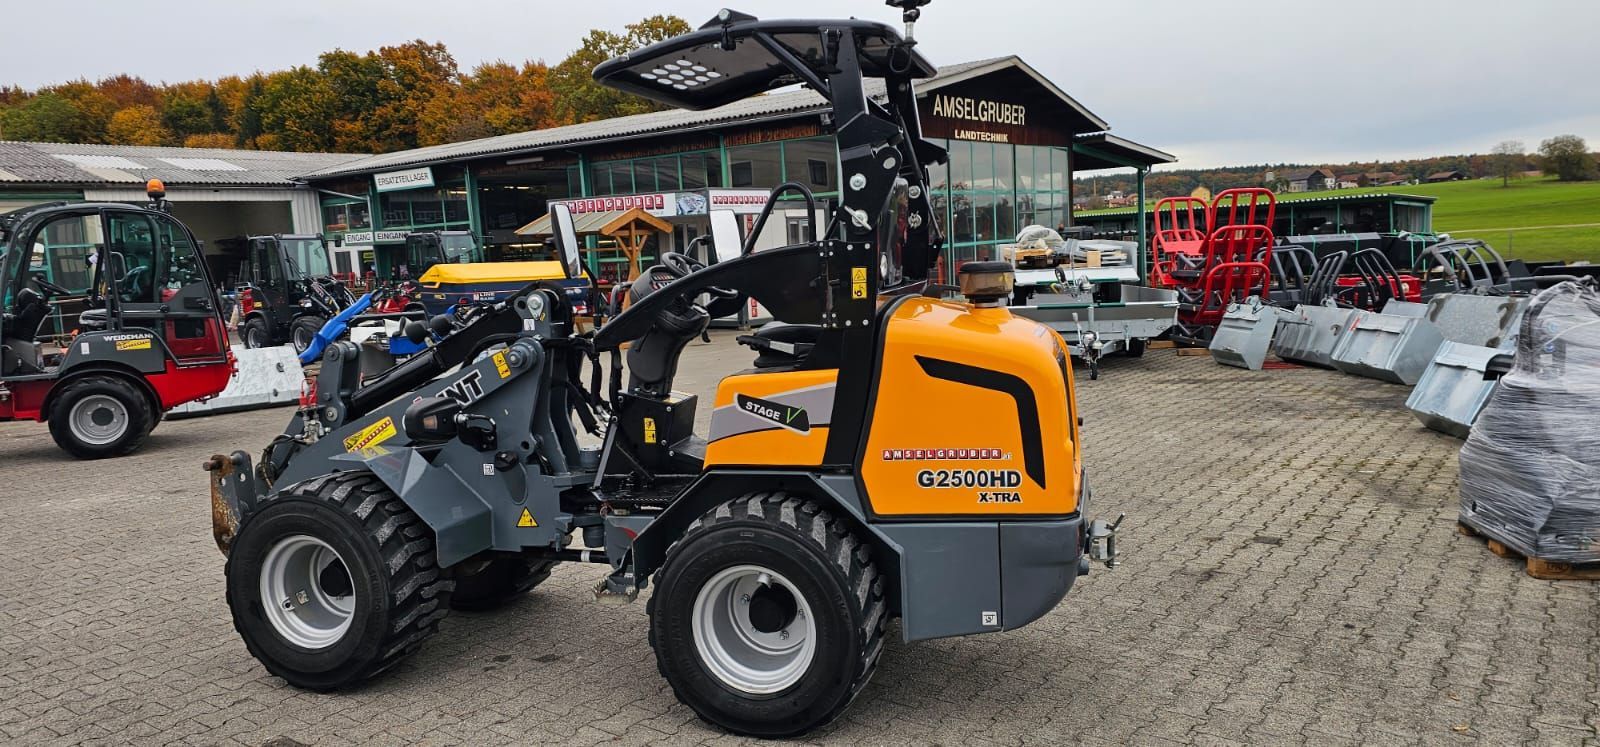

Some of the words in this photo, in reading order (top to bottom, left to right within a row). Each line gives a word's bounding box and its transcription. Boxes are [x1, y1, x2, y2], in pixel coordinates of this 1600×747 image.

[933, 94, 1025, 126] AMSELGRUBER
[954, 129, 1009, 143] LANDTECHNIK
[377, 172, 430, 187] ERSATZTEILLAGER
[566, 195, 664, 213] MSELGRUBER
[346, 233, 371, 241] EINGANG
[745, 401, 781, 421] STAGE
[917, 468, 1022, 488] G2500HD
[977, 491, 1022, 504] X-TRA
